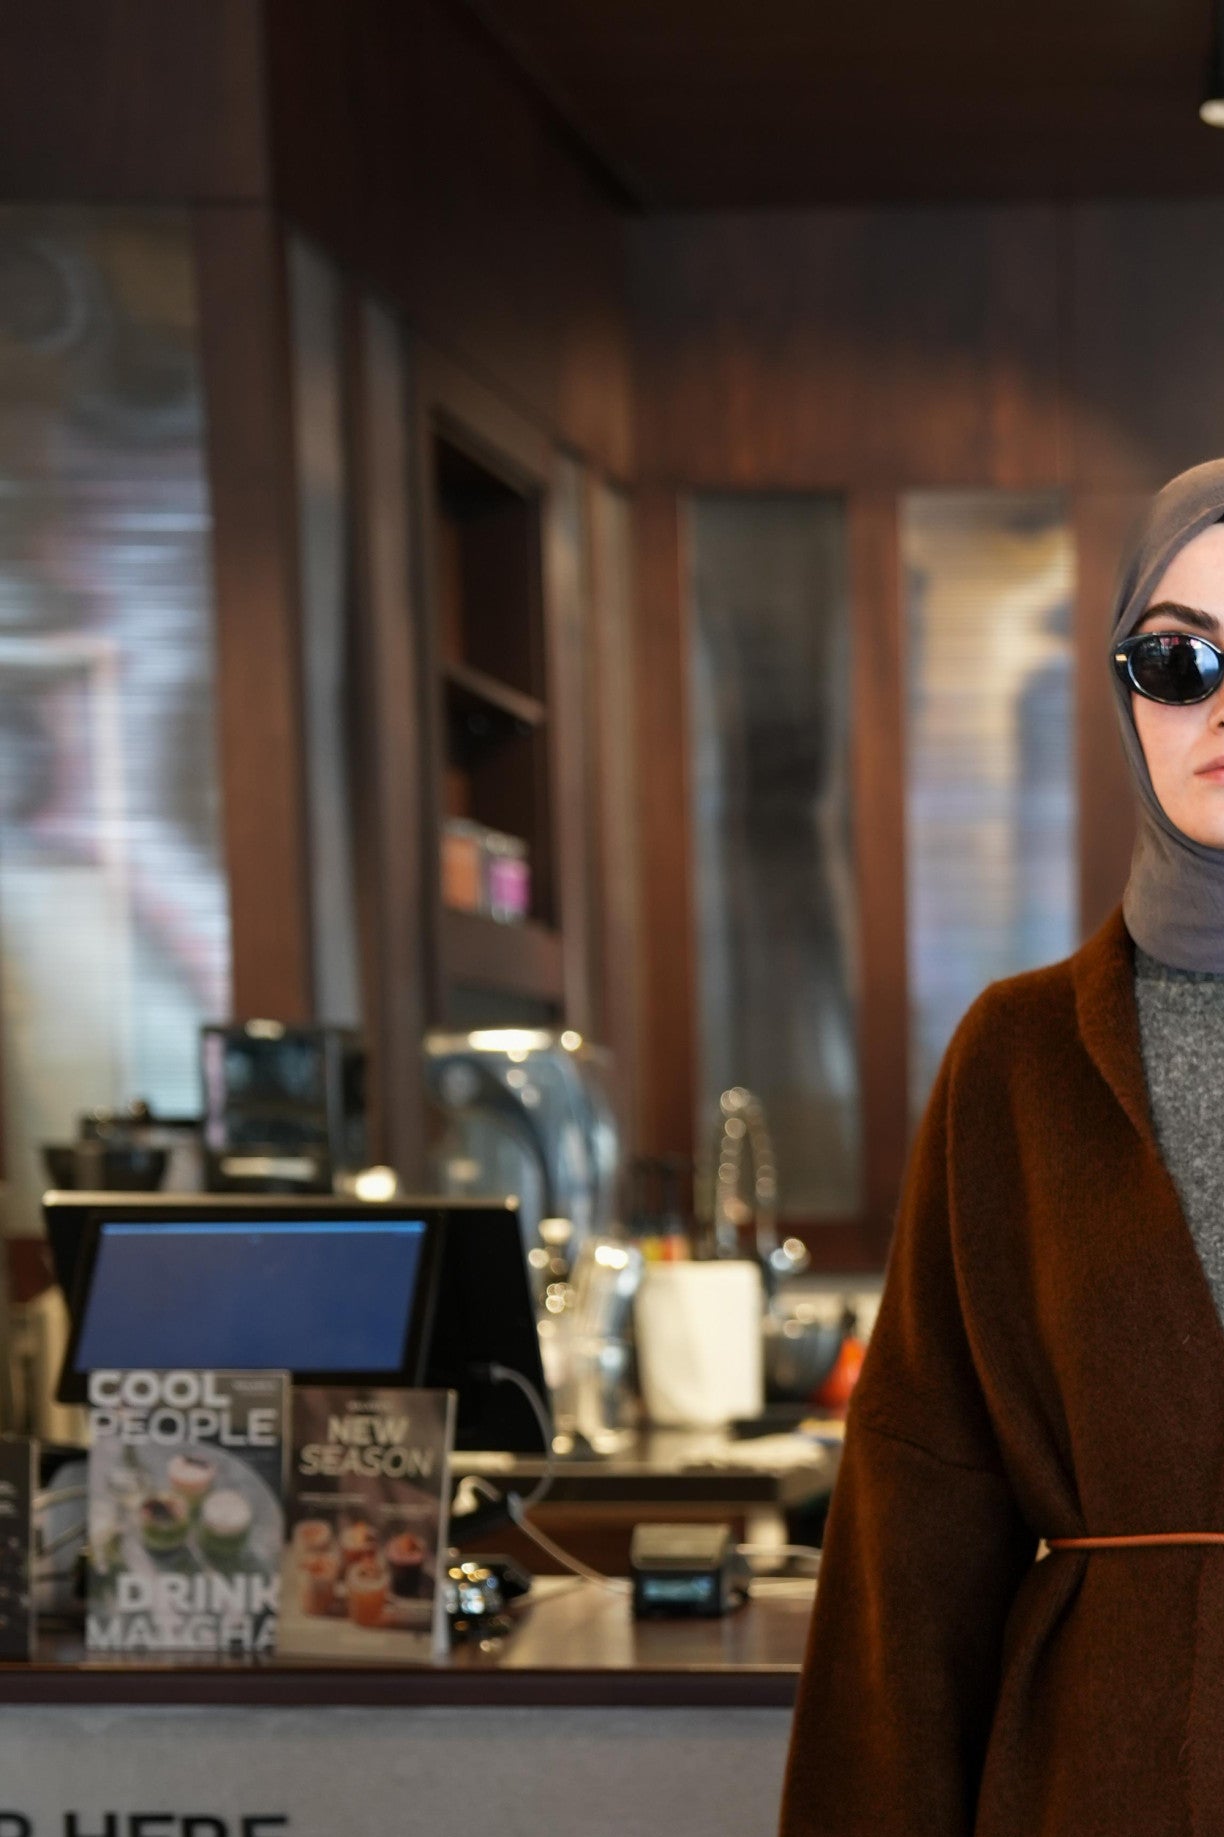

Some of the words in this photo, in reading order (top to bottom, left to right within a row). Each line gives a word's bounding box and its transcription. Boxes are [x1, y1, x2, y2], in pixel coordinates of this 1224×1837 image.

[89, 1371, 231, 1408] COOL
[89, 1408, 277, 1446] PEOPLE
[327, 1415, 410, 1446] NEW
[299, 1443, 434, 1478] SEASON
[117, 1573, 280, 1615] DRINK
